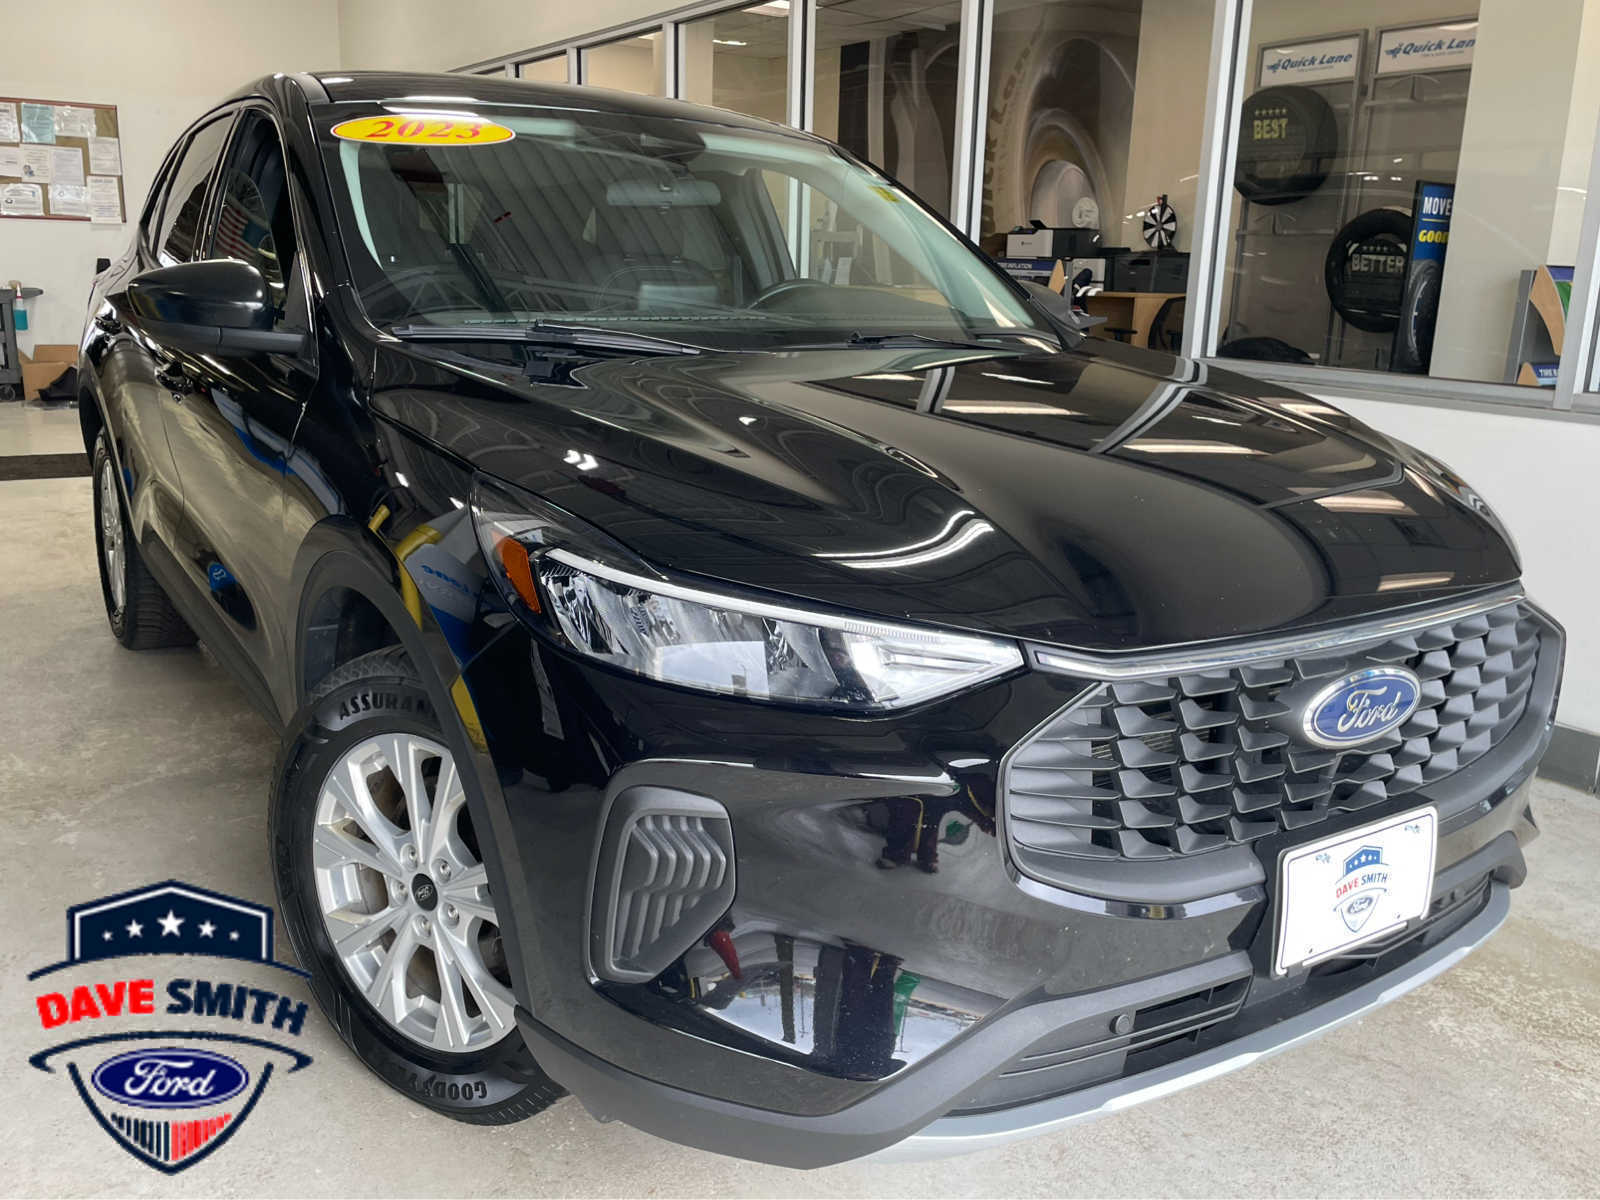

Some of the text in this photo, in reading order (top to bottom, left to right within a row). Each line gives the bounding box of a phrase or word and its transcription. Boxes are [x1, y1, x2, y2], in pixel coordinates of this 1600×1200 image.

[1402, 39, 1442, 55] Quick
[1447, 38, 1477, 49] Lan
[1281, 56, 1316, 70] Quick
[1319, 54, 1352, 65] Lane
[366, 119, 482, 139] 2023
[1253, 118, 1288, 139] BEST
[1423, 196, 1453, 216] MOVE
[1351, 253, 1405, 273] BETTER
[1337, 686, 1402, 733] Ford
[1336, 872, 1388, 898] DAVE SMITH
